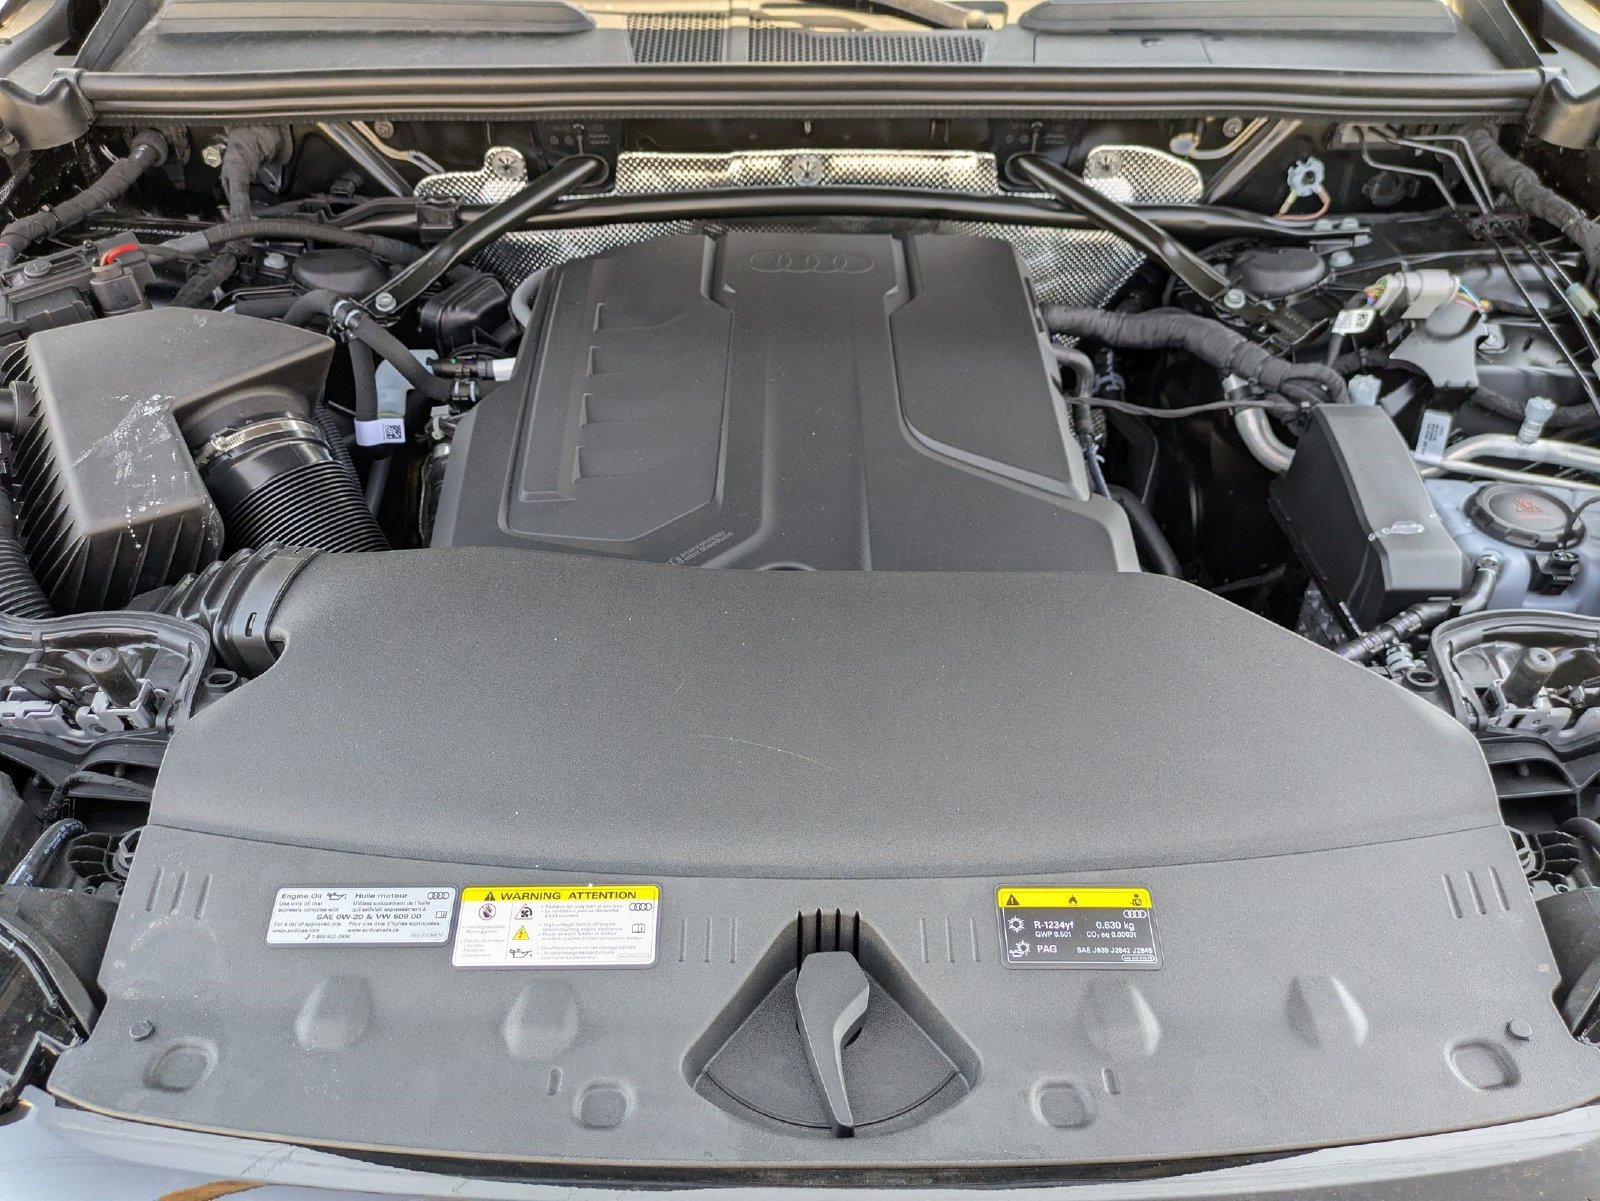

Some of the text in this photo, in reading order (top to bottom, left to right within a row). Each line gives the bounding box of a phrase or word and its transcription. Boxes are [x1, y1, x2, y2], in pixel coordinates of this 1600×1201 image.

[501, 891, 636, 900] WARNING ATTENTION
[1034, 921, 1135, 931] R-1234yf 0.630 kg
[1037, 945, 1057, 953] PAG
